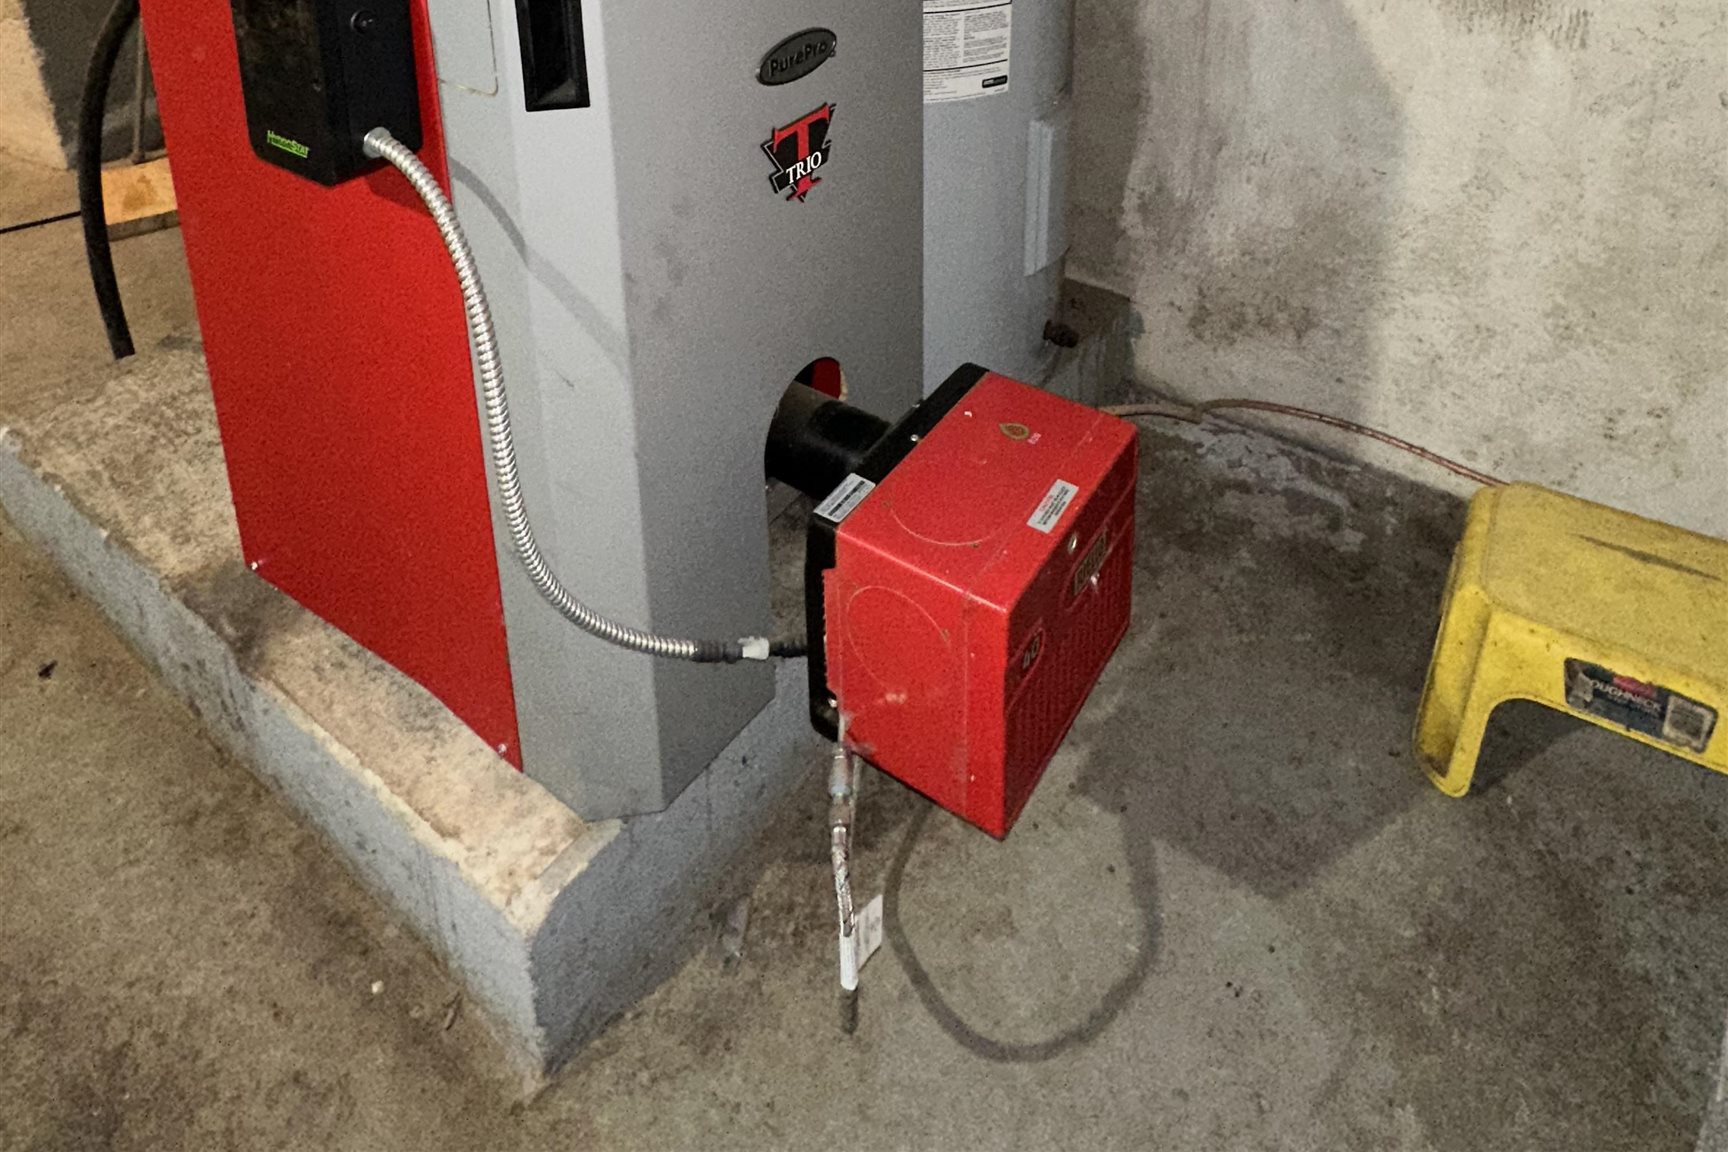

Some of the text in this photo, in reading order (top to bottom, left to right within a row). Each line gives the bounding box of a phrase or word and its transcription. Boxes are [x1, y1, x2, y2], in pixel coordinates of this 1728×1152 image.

[768, 42, 827, 77] PurePro
[785, 151, 822, 185] TRIO
[1590, 679, 1661, 712] OUGHNECK
